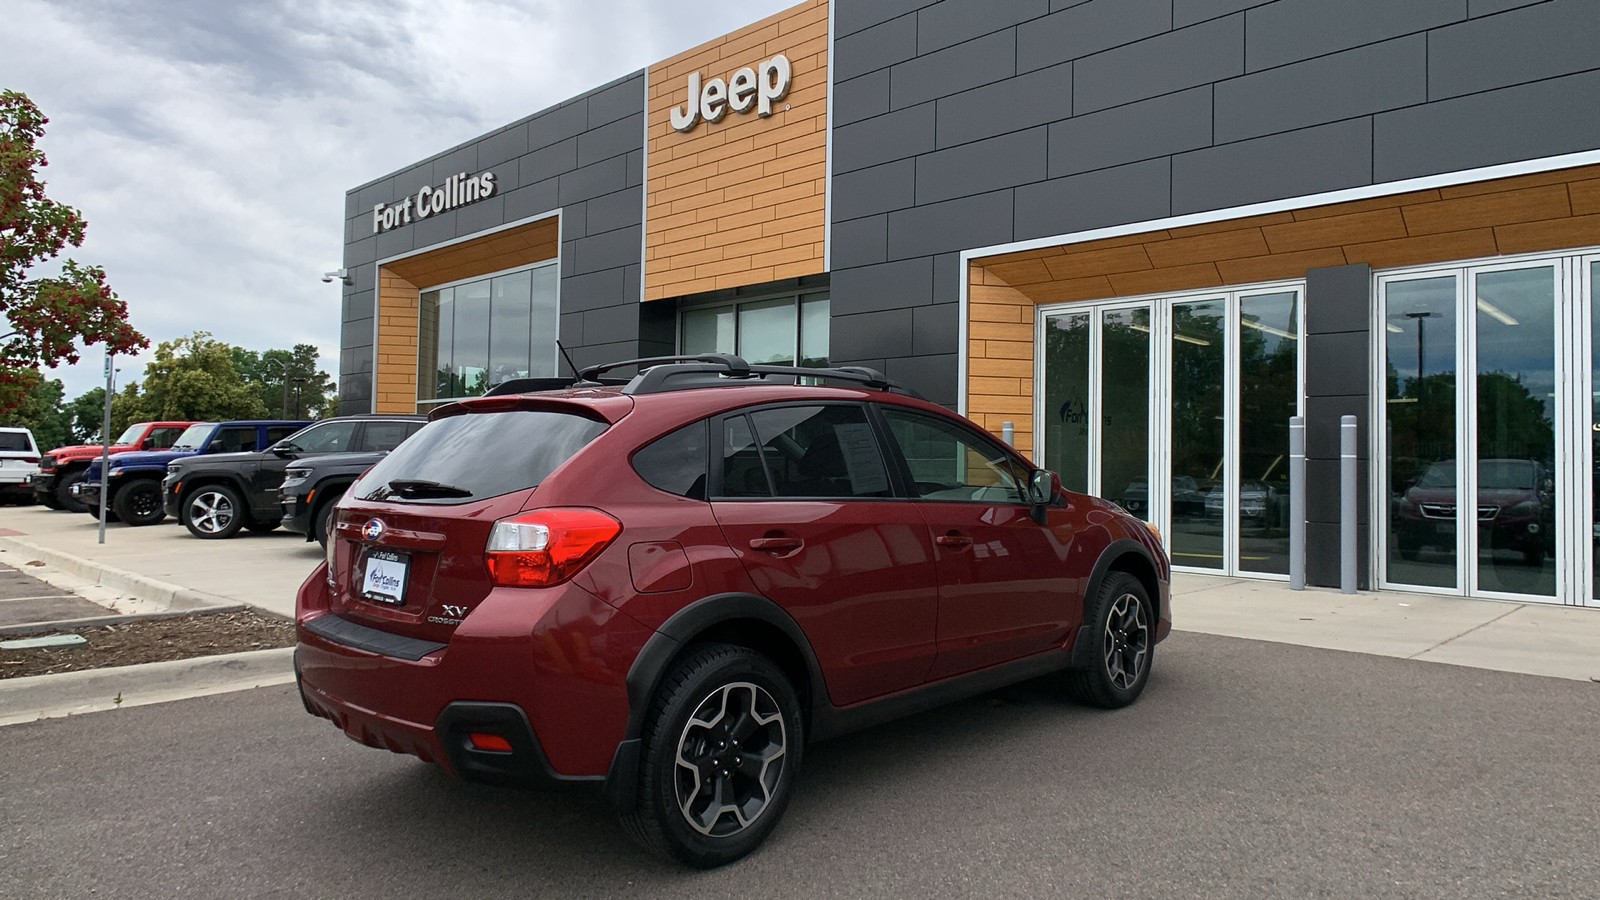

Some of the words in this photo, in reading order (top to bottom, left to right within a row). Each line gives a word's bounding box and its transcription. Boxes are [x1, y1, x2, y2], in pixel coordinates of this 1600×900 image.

[670, 54, 792, 132] Jeep
[373, 196, 412, 233] Fort
[417, 171, 496, 218] Collins
[373, 573, 383, 583] Fort
[382, 575, 400, 587] Collins
[442, 604, 467, 617] XV
